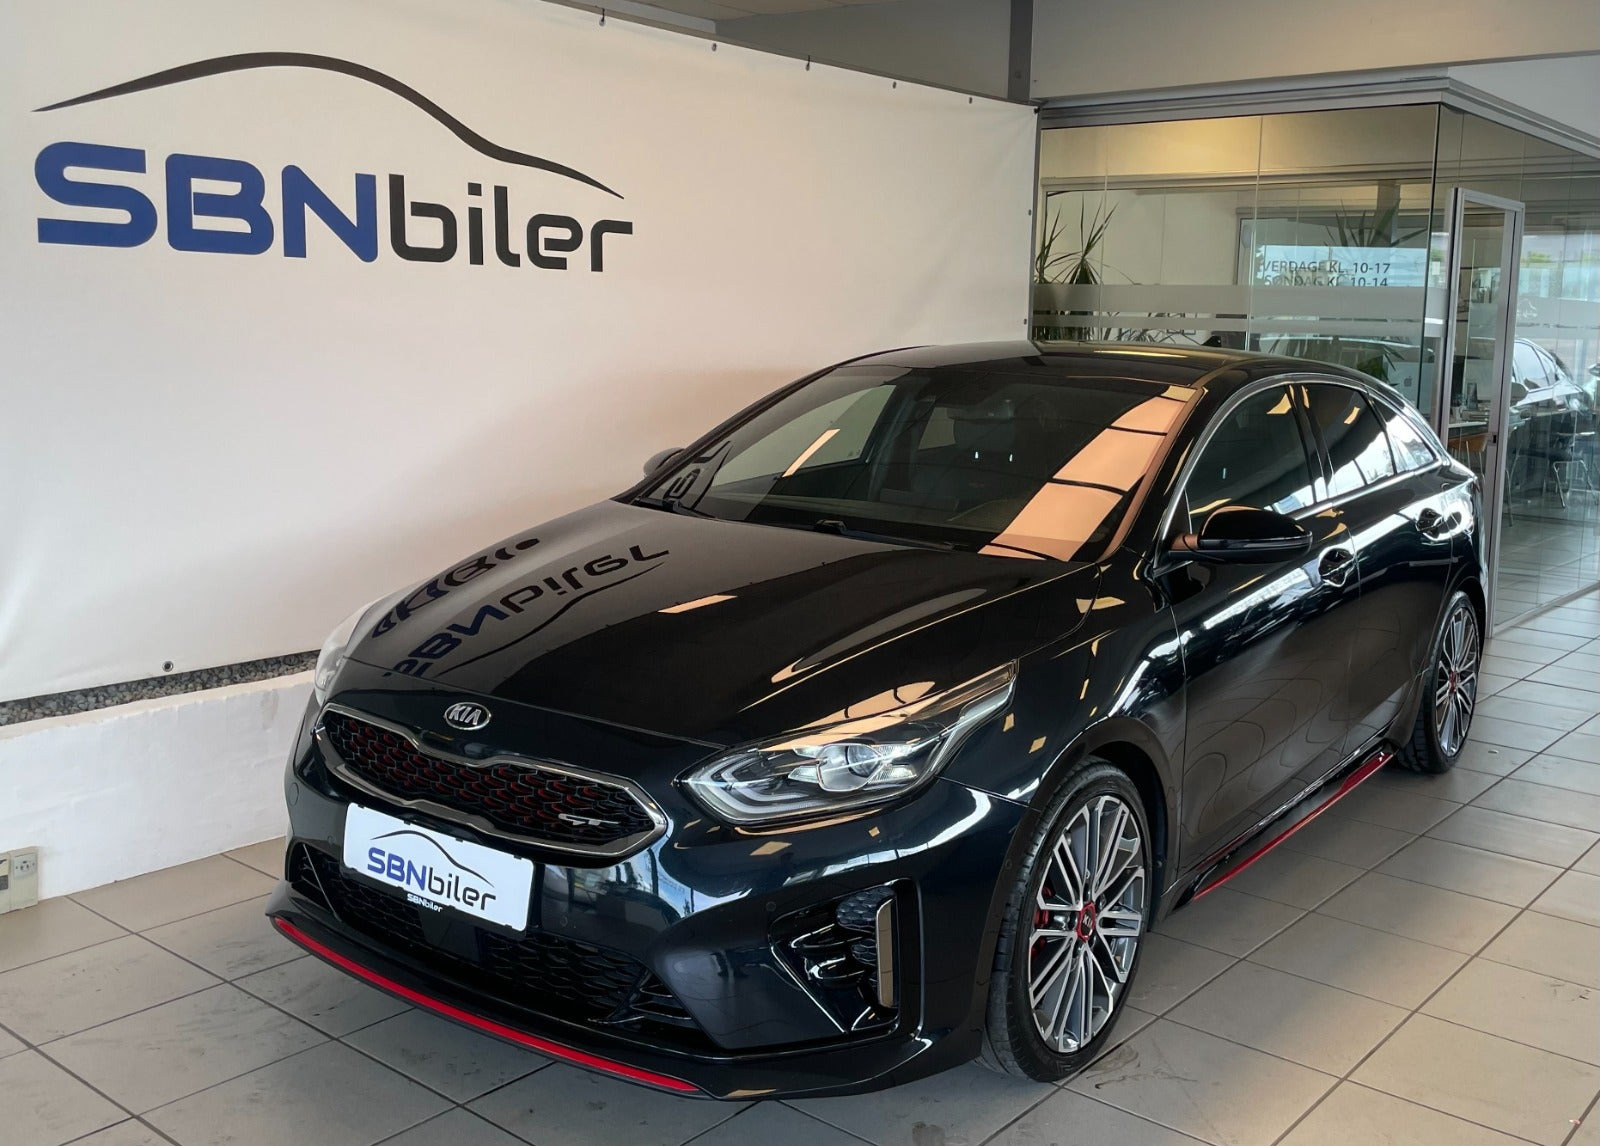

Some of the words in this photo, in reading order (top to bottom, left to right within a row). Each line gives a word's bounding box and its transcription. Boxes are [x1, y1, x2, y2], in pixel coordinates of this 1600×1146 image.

[34, 141, 633, 272] SBNbiler
[1353, 262, 1390, 273] 10-17
[448, 704, 482, 726] KIA
[367, 847, 496, 911] SBNbiler
[406, 893, 443, 913] SBNbiler
